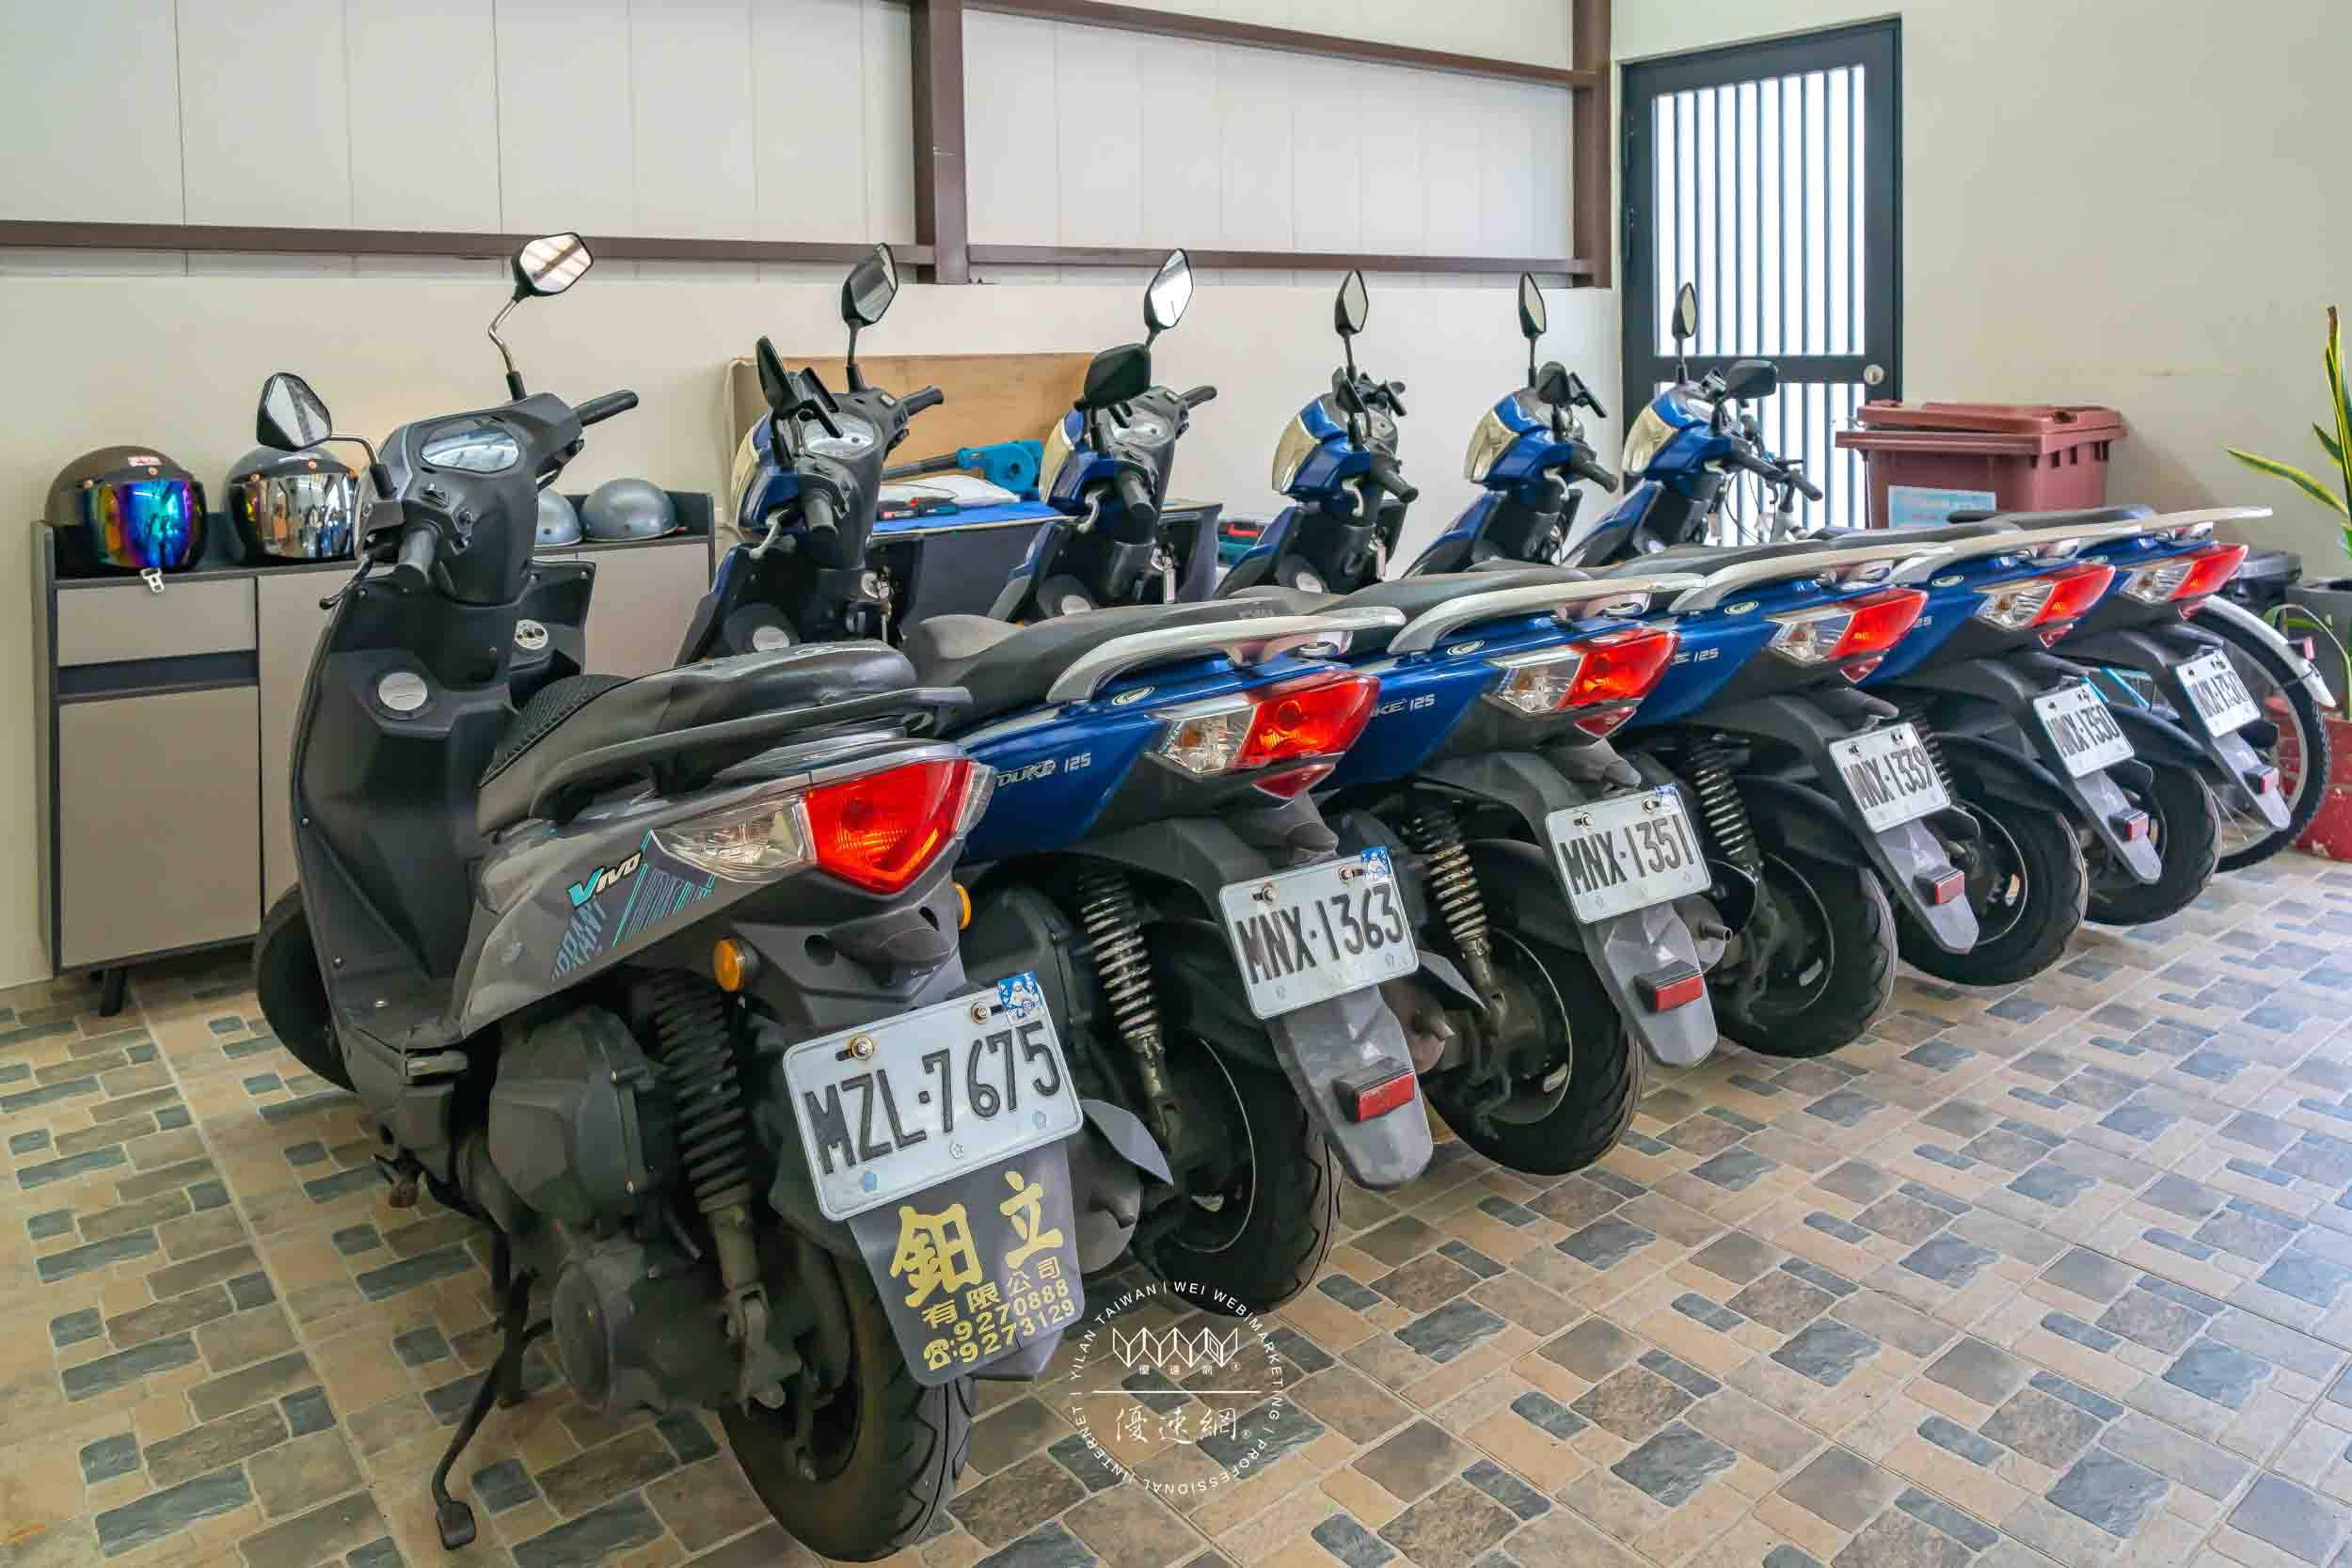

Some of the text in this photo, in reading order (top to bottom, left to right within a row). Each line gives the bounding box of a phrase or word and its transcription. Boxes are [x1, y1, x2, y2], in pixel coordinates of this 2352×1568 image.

[1409, 693, 1435, 713] 125
[1064, 752, 1091, 773] 125
[920, 1256, 1061, 1330] 有限公司
[953, 1278, 1070, 1342] 9270888
[959, 1298, 1075, 1363] 9273129
